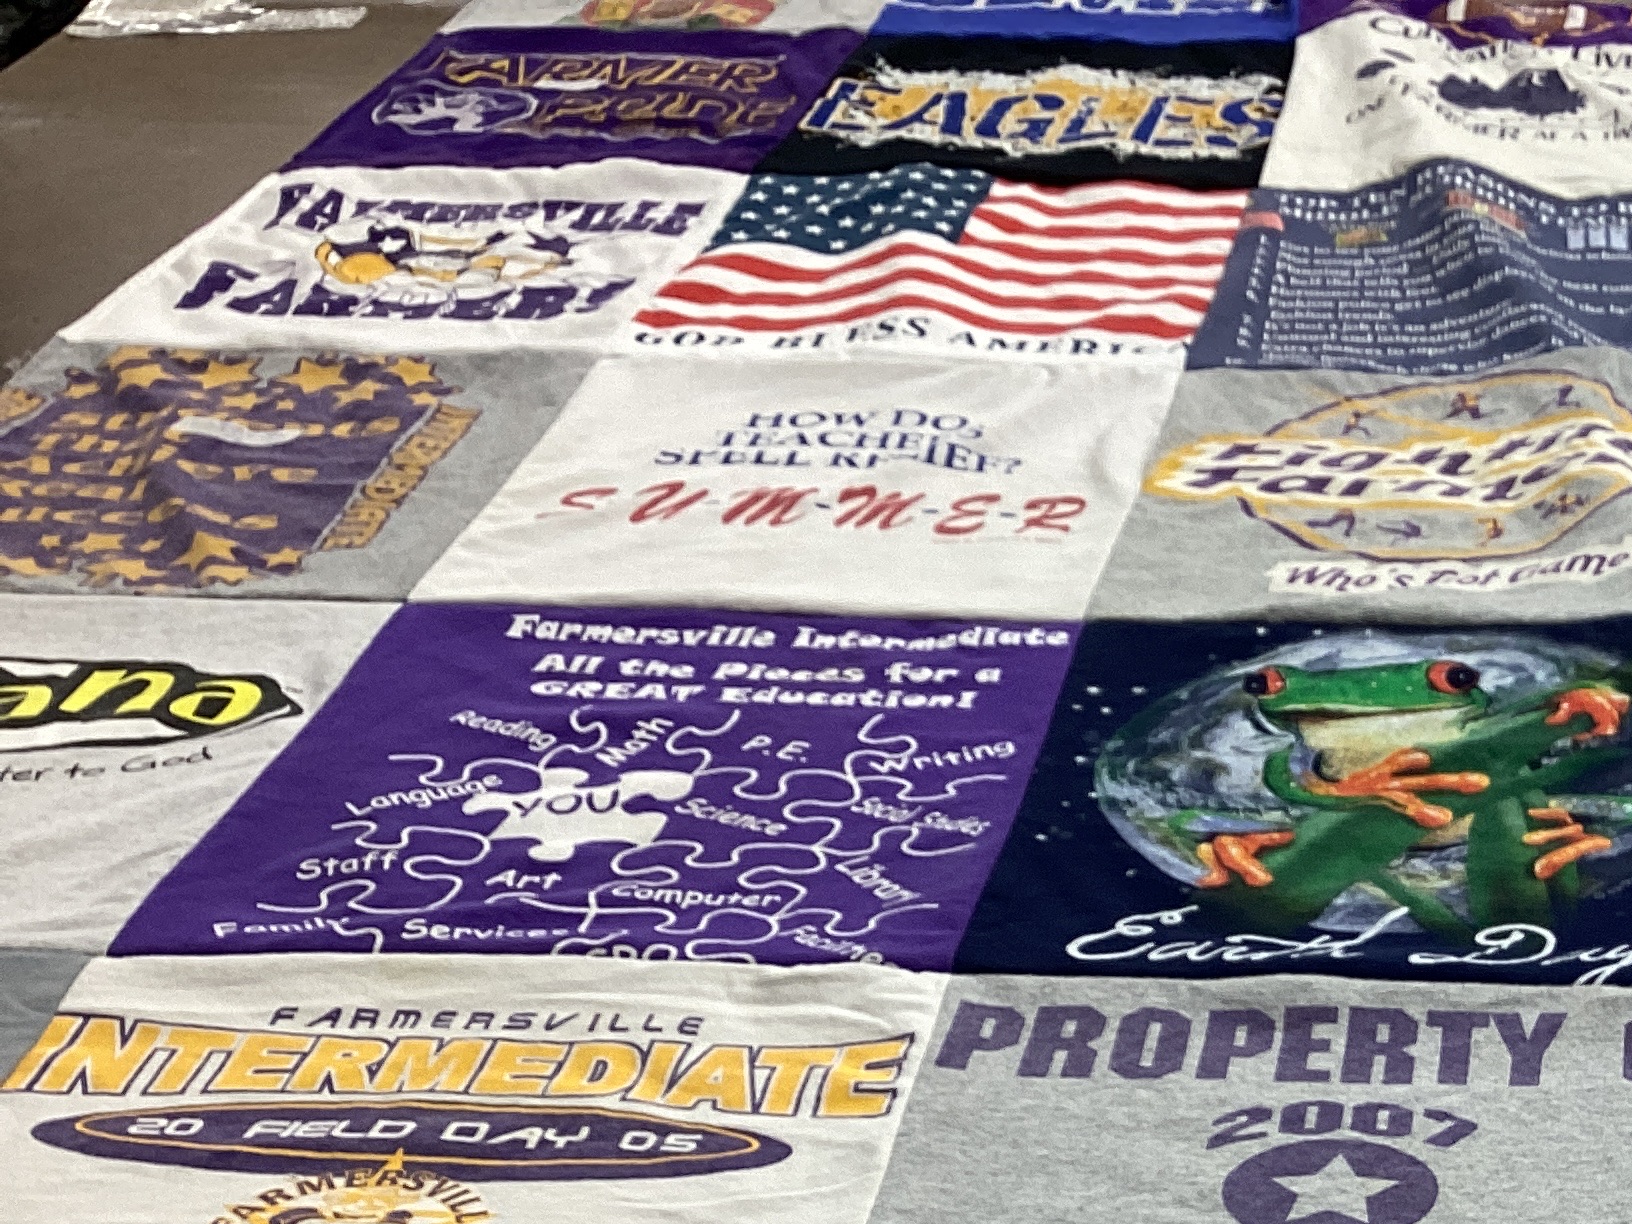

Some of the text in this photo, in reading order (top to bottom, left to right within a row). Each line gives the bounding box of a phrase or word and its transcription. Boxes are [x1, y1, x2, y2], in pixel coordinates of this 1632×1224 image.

[800, 78, 1283, 150] EAGLES
[745, 410, 877, 429] HOW
[504, 612, 1071, 652] Farmersville Intermediate
[532, 653, 604, 676] All
[617, 656, 696, 680] the
[884, 661, 960, 684] for
[974, 665, 1003, 684] a
[530, 680, 707, 702] GREAT
[450, 708, 560, 752] Reading
[595, 715, 675, 768] Math
[121, 745, 214, 773] God
[869, 739, 1017, 774] Writing
[345, 772, 504, 816] Language
[673, 797, 788, 837] Science
[295, 849, 400, 881] Staff
[486, 869, 563, 890] Art
[611, 883, 782, 910] Computer
[212, 915, 350, 939] Family
[269, 1006, 705, 1035] FARMERSVILLE
[933, 999, 1568, 1088] PROPERTY
[0, 1010, 915, 1118] INTERMEDIATE
[126, 1117, 205, 1137] 20
[241, 1117, 420, 1140] FIELD
[438, 1119, 590, 1150] DAY
[1205, 1098, 1480, 1151] 2007
